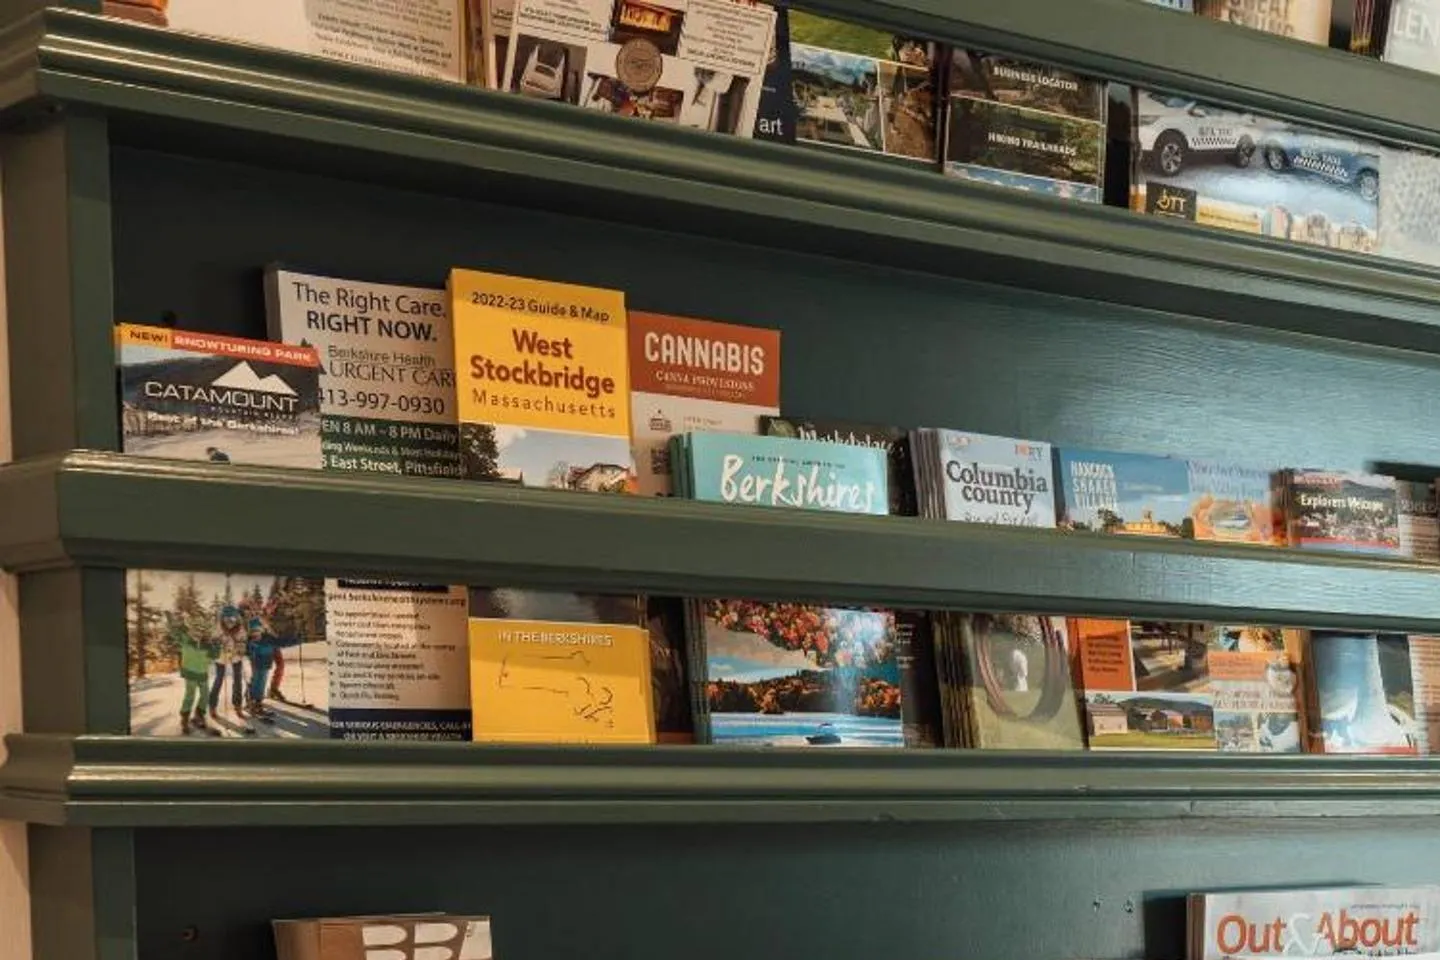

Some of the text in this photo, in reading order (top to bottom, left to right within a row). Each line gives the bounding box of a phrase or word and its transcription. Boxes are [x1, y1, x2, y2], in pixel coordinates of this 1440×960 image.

[1038, 75, 1078, 91] LOCATOR
[292, 282, 447, 318] The Right Care.
[471, 290, 610, 325] 2022-23 Guide & Map
[306, 310, 438, 343] RIGHT NOW.
[130, 330, 168, 343] NEW!
[275, 348, 311, 362] PARK
[328, 344, 436, 368] Berkshire Health
[511, 327, 574, 360] West
[644, 331, 765, 376] CANNABIS
[329, 360, 406, 383] URGENT
[470, 354, 616, 399] Stockbridge
[144, 381, 299, 412] CATAMOUNT
[472, 387, 616, 419] Massachusetts
[342, 421, 351, 435] 8
[354, 422, 377, 437] AM
[389, 425, 398, 439] 8
[400, 425, 422, 440] PM
[330, 455, 358, 470] East
[360, 457, 402, 475] Street,
[946, 460, 1049, 493] Columbia
[720, 452, 877, 514] Berkshires
[961, 485, 1035, 515] county
[515, 630, 540, 644] THE
[1216, 912, 1287, 955] Out
[1316, 908, 1420, 950] About
